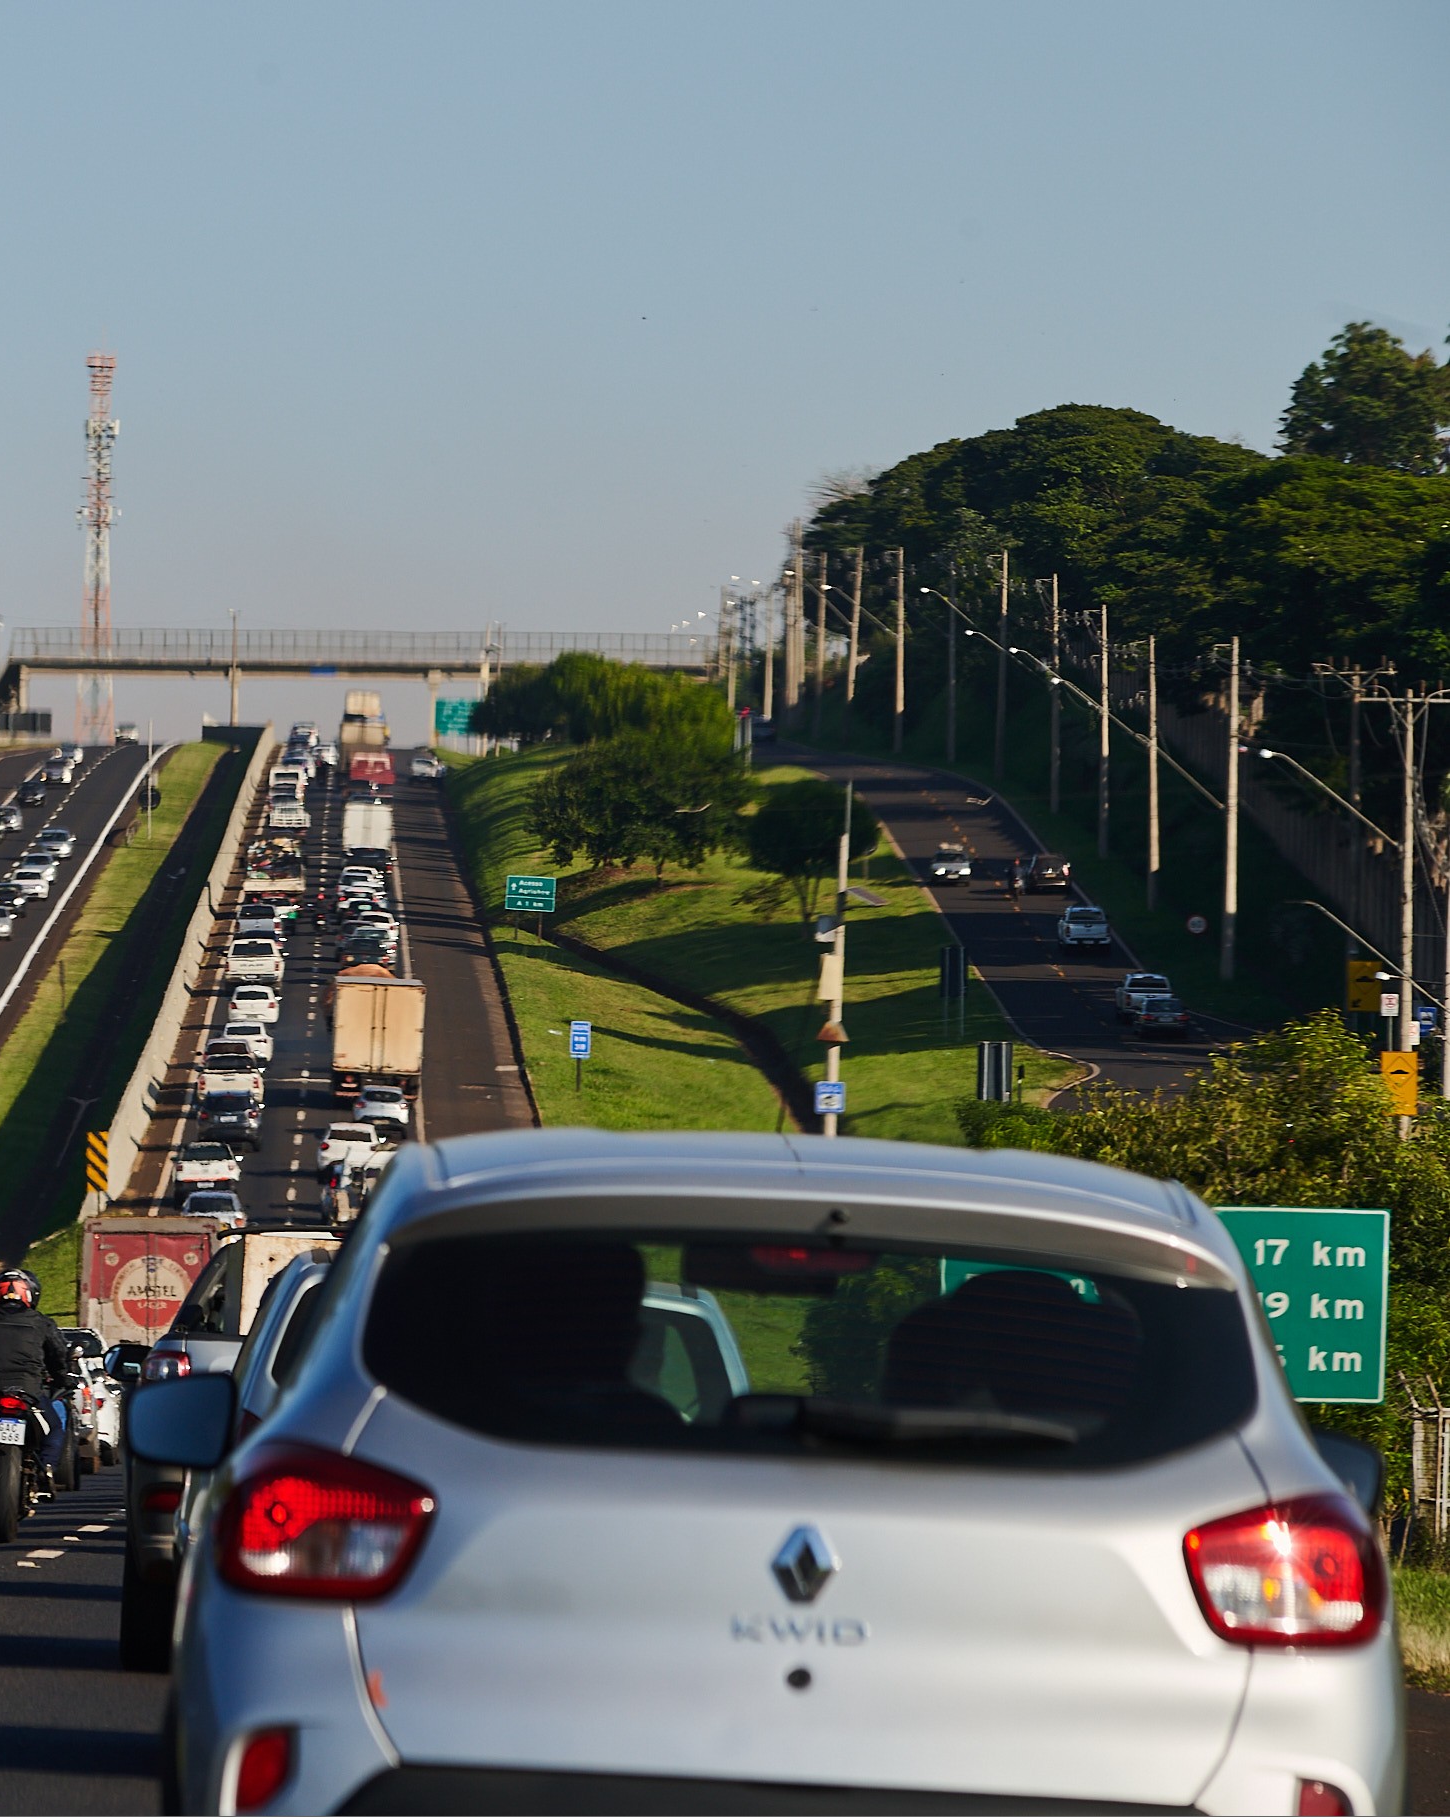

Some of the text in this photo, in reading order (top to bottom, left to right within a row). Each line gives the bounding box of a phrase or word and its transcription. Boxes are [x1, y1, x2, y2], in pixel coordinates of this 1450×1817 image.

[1254, 1238, 1366, 1267] 17 km
[127, 1285, 177, 1298] AMSTEL
[1309, 1293, 1364, 1320] km
[1307, 1345, 1362, 1373] km
[729, 1613, 871, 1647] KWID
